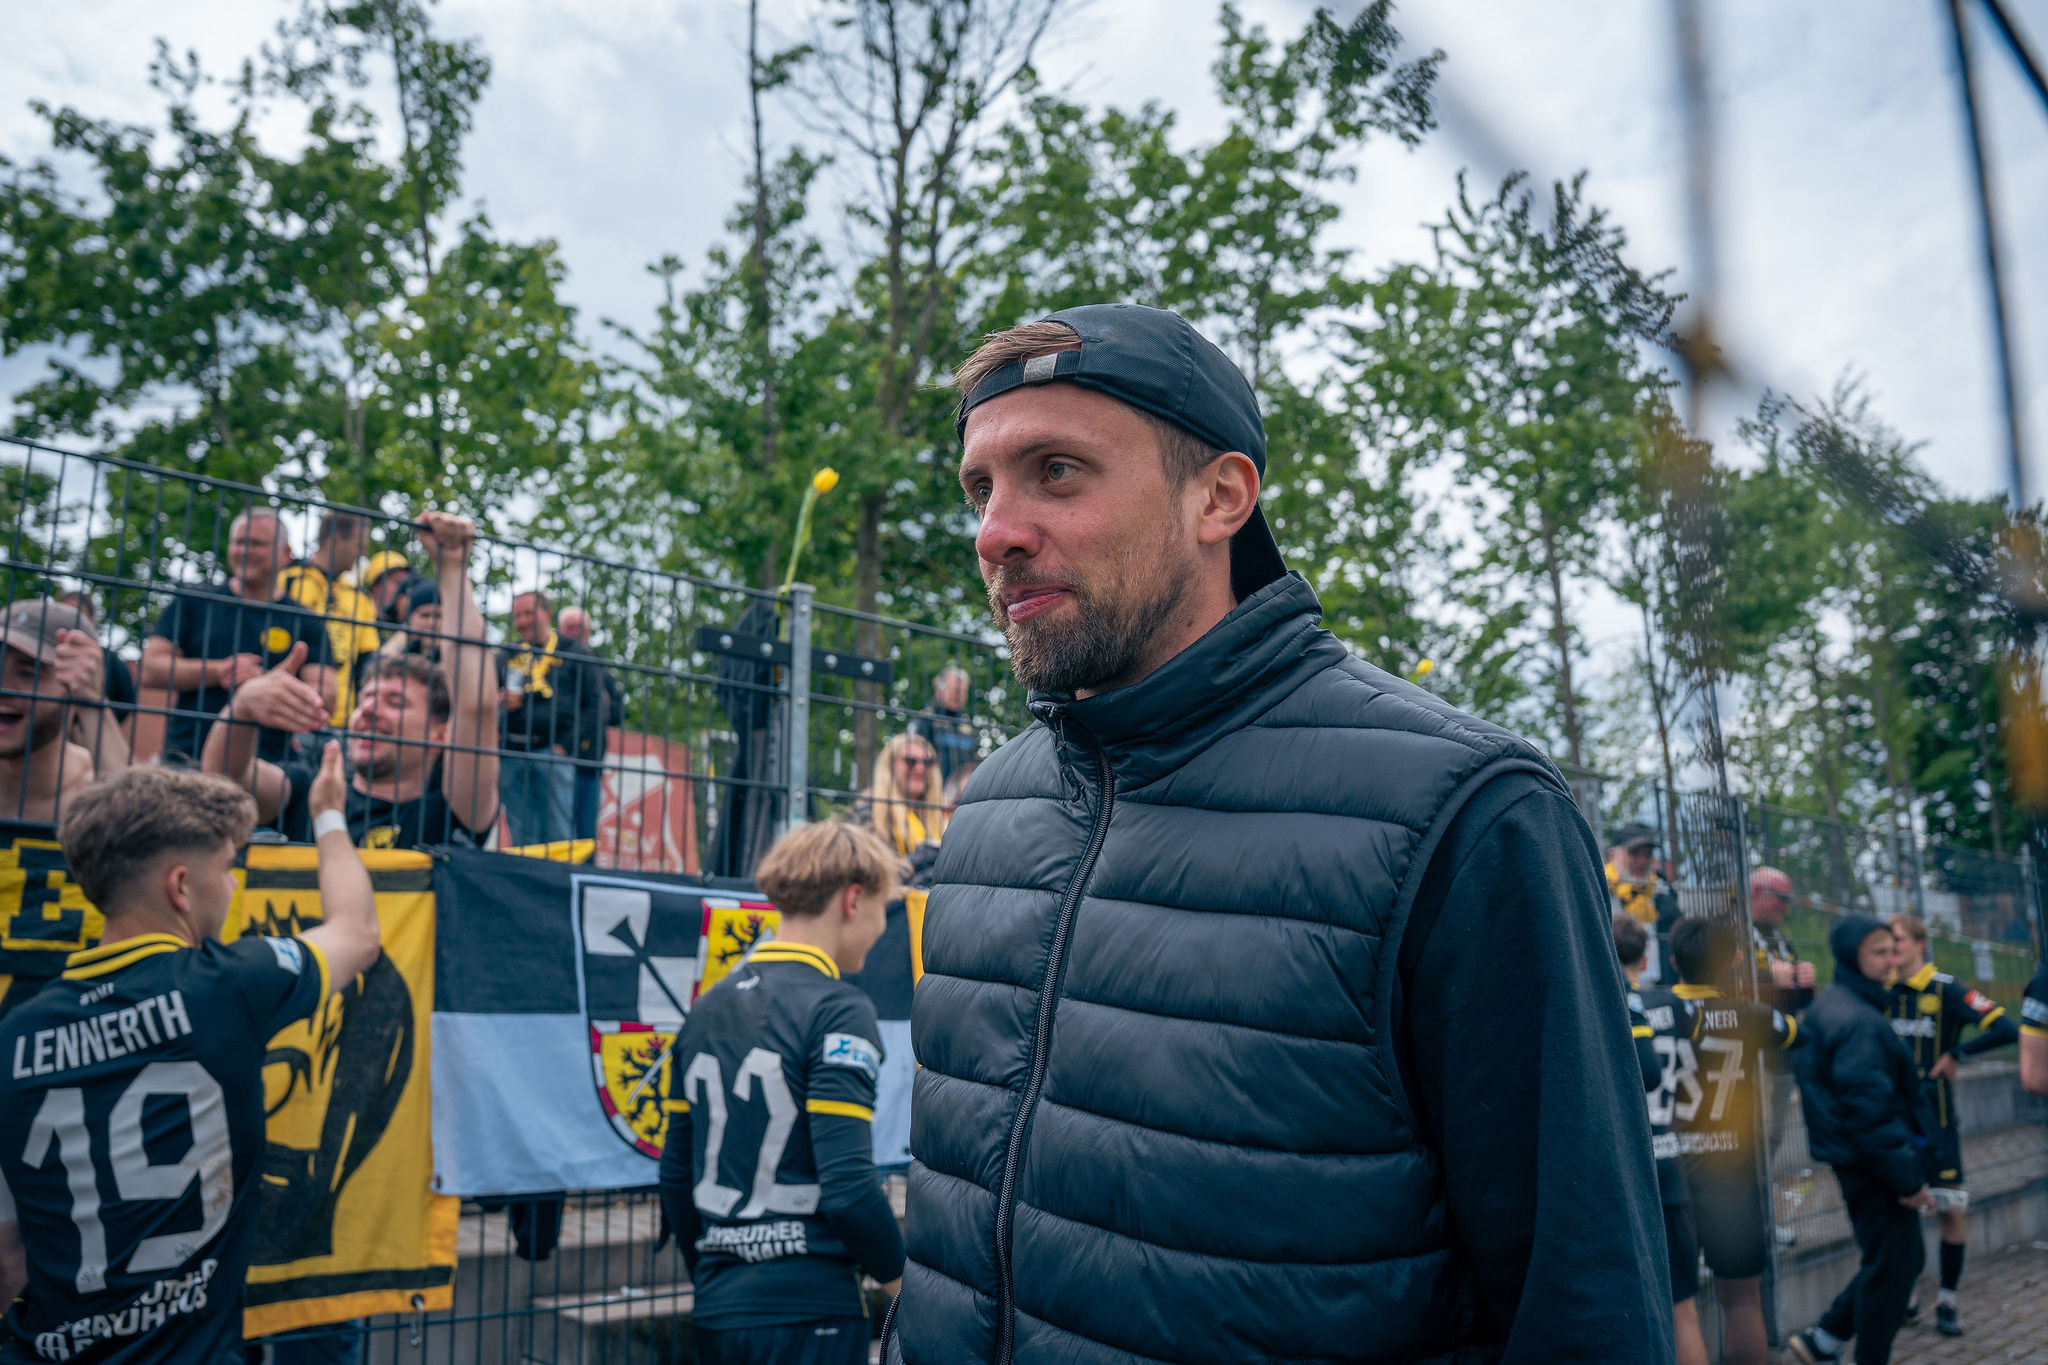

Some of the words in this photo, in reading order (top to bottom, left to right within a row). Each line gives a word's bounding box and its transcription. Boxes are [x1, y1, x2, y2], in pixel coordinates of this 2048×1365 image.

[12, 990, 193, 1080] LENNERTH
[21, 1060, 233, 1294] 19
[684, 1047, 821, 1219] 22
